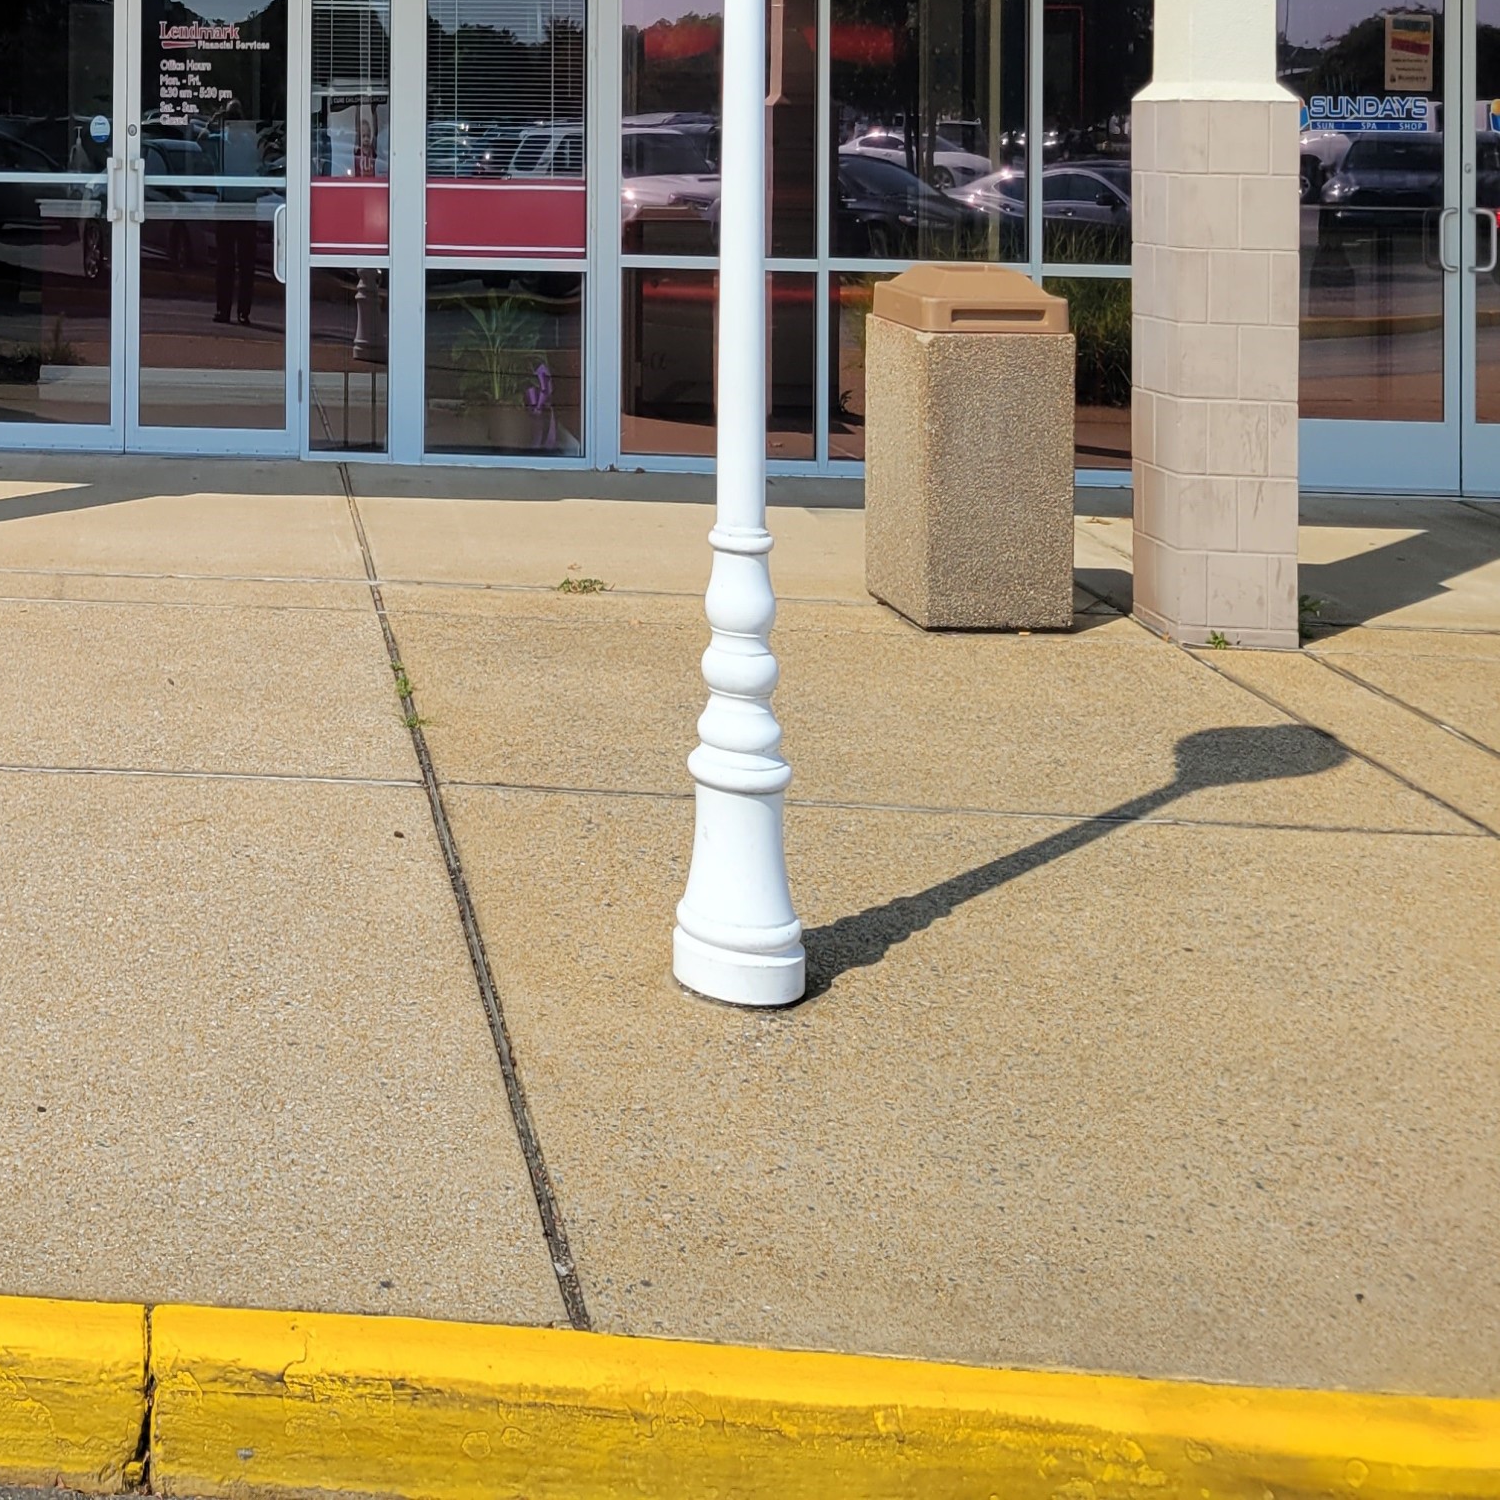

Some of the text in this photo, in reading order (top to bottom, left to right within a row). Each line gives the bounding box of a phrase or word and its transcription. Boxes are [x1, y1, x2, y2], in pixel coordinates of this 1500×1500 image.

[159, 21, 240, 40] Lendmark
[197, 40, 271, 50] Financial Services
[160, 59, 212, 71] Office Hours
[1310, 95, 1428, 119] SUNDAYS
[1316, 122, 1423, 130] SUN SPA SHOP
